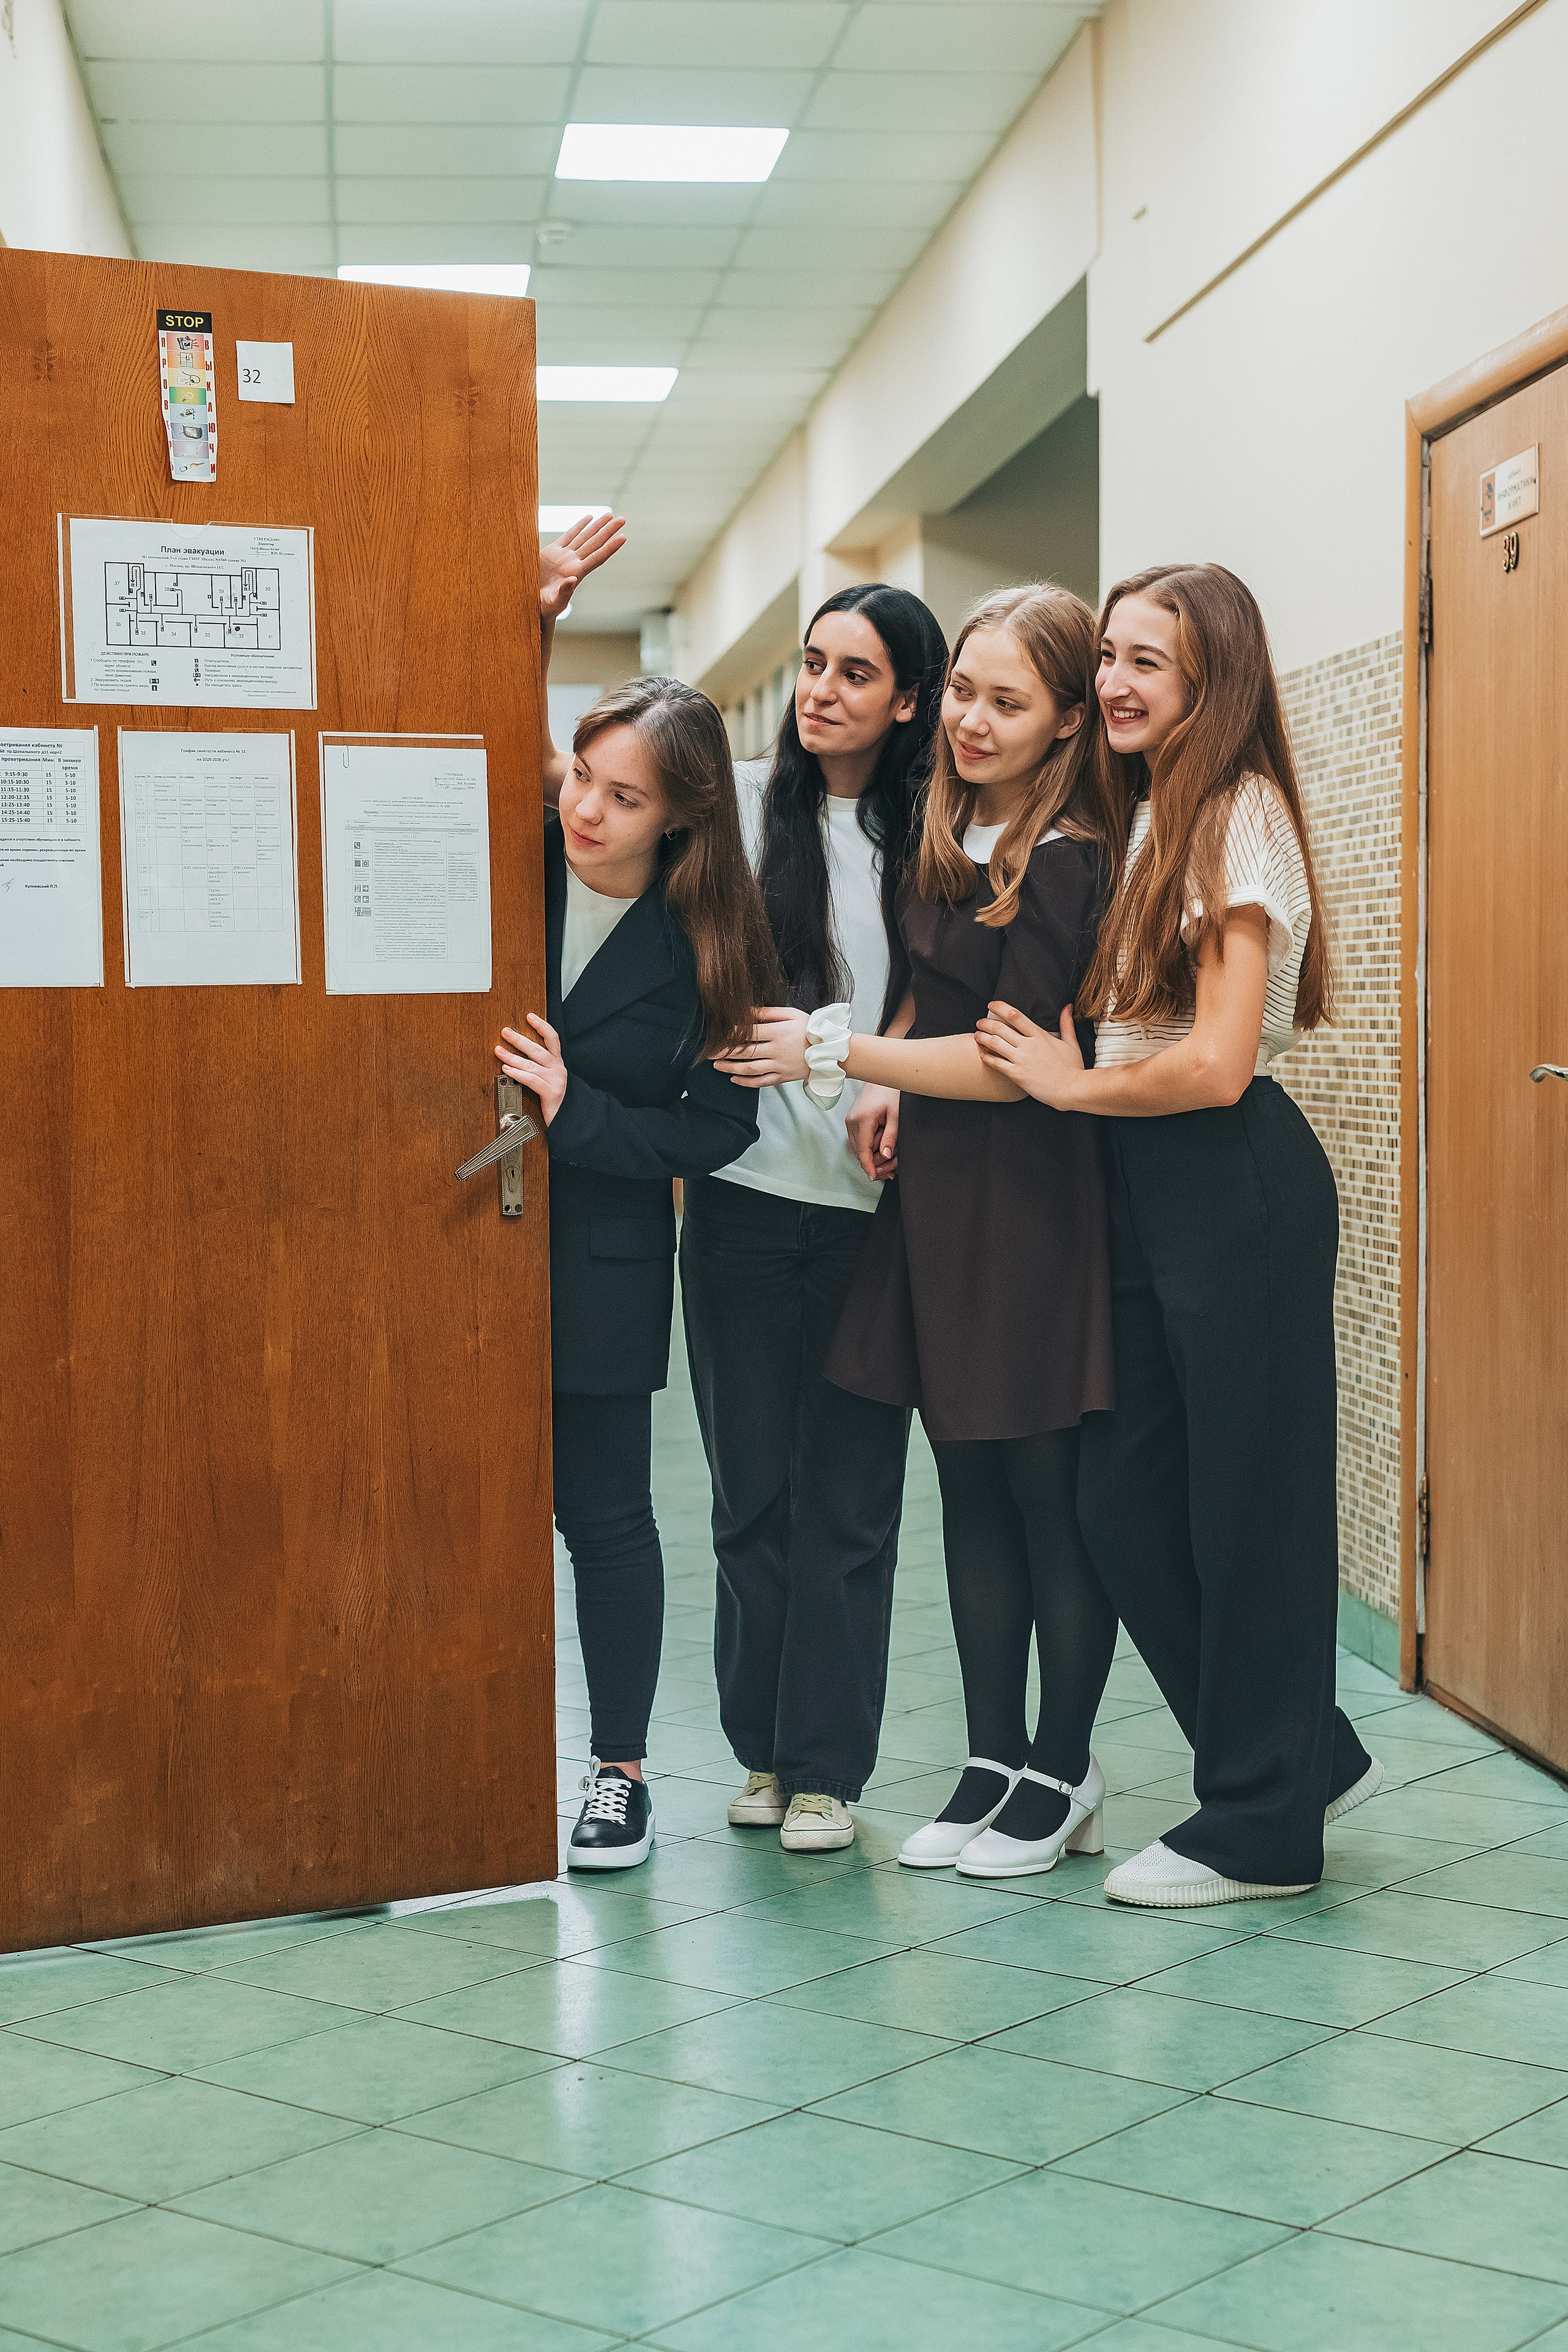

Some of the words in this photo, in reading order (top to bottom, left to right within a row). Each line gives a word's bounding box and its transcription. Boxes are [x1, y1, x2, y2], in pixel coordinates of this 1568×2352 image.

[165, 315, 204, 328] STOP
[243, 369, 261, 383] 32
[205, 340, 216, 473] ВЫКЛЮЧИ
[1502, 532, 1517, 570] 39
